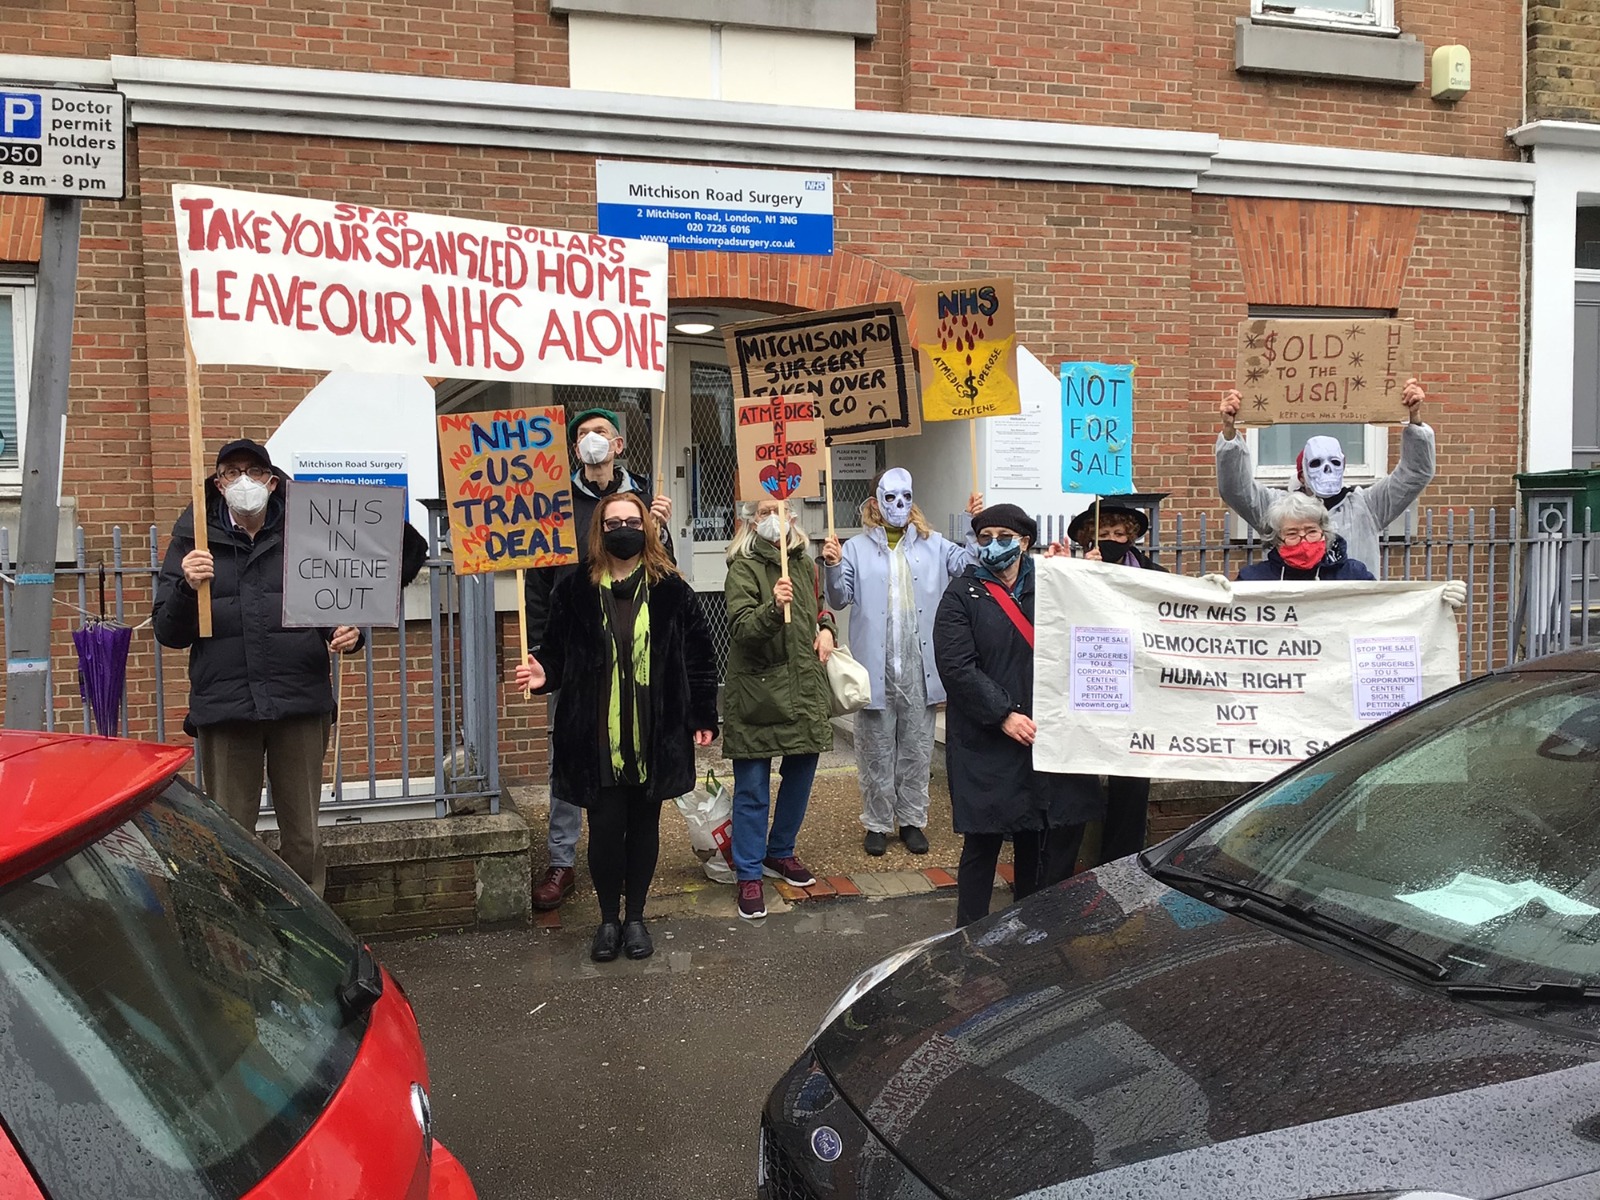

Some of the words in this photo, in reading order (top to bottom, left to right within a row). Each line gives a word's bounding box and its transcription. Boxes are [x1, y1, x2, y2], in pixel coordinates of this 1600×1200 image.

[4, 98, 34, 134] P
[52, 97, 113, 114] Doctor
[52, 118, 112, 132] permit
[48, 133, 116, 150] holders
[62, 152, 101, 169] only
[3, 171, 14, 185] 8
[19, 174, 46, 186] am
[62, 174, 74, 188] 8
[79, 178, 106, 190] pm
[806, 181, 825, 190] NHS
[629, 184, 700, 200] Mitchison
[706, 188, 743, 202] Road
[749, 190, 803, 208] Surgery
[334, 203, 409, 228] STAR
[637, 209, 643, 218] 2
[646, 209, 692, 220] Mitchison
[695, 212, 722, 222] Road,
[725, 213, 762, 224] London,
[765, 216, 776, 224] N1
[780, 216, 798, 225] 3NG
[687, 223, 703, 232] 020
[706, 224, 727, 233] 7226
[730, 225, 751, 234] 6016
[179, 198, 272, 254] TAKE
[271, 210, 372, 262] YOUR
[375, 226, 528, 290] SPANGLED
[506, 226, 626, 264] DOLLARS
[640, 234, 796, 248] www.mitchisonroadsurgery.co.uk
[537, 250, 651, 308] HOME
[937, 286, 999, 320] NHS
[190, 268, 319, 330] LEAVE
[319, 283, 417, 346] OUR
[422, 284, 525, 372] NHS
[538, 308, 667, 373] ALONE
[742, 326, 858, 364] MITCHISON
[861, 322, 890, 343] RD
[764, 348, 868, 384] SURGERY
[977, 347, 1002, 387] OPEROSE
[1276, 366, 1297, 380] TO
[1309, 366, 1337, 378] THE
[1384, 325, 1402, 397] HELP
[829, 369, 887, 396] OVER
[1066, 374, 1126, 408] NOT
[1285, 377, 1350, 410] USA!
[951, 404, 997, 416] CENTENE
[440, 414, 474, 432] NO
[470, 417, 553, 453] NHS
[1070, 418, 1118, 444] FOR
[449, 444, 472, 471] NO
[756, 442, 817, 460] OPEROSE
[299, 460, 343, 468] Mitchison
[346, 460, 367, 468] Road
[370, 460, 404, 470] Surgery
[533, 451, 563, 481] NO
[358, 477, 386, 485] Hours:
[309, 498, 382, 526] NHS
[452, 490, 572, 528] TRADE
[694, 517, 720, 528] Push
[328, 529, 357, 552] IN
[462, 524, 490, 554] NO
[485, 526, 575, 561] DEAL
[298, 558, 388, 580] CENTENE
[314, 587, 374, 610] OUT
[1158, 601, 1199, 620] OUR
[1206, 605, 1246, 622] NHS
[1256, 606, 1276, 622] IS
[1284, 606, 1298, 622] A
[1112, 636, 1128, 644] SALE
[1142, 632, 1268, 656] DEMOCRATIC
[1278, 639, 1322, 656] AND
[1160, 667, 1228, 688] HUMAN
[1242, 672, 1307, 689] RIGHT
[1216, 704, 1259, 721] NOT
[1129, 732, 1155, 750] AN
[1168, 735, 1236, 754] ASSET
[1248, 738, 1292, 756] FOR
[1305, 740, 1331, 757] SA
